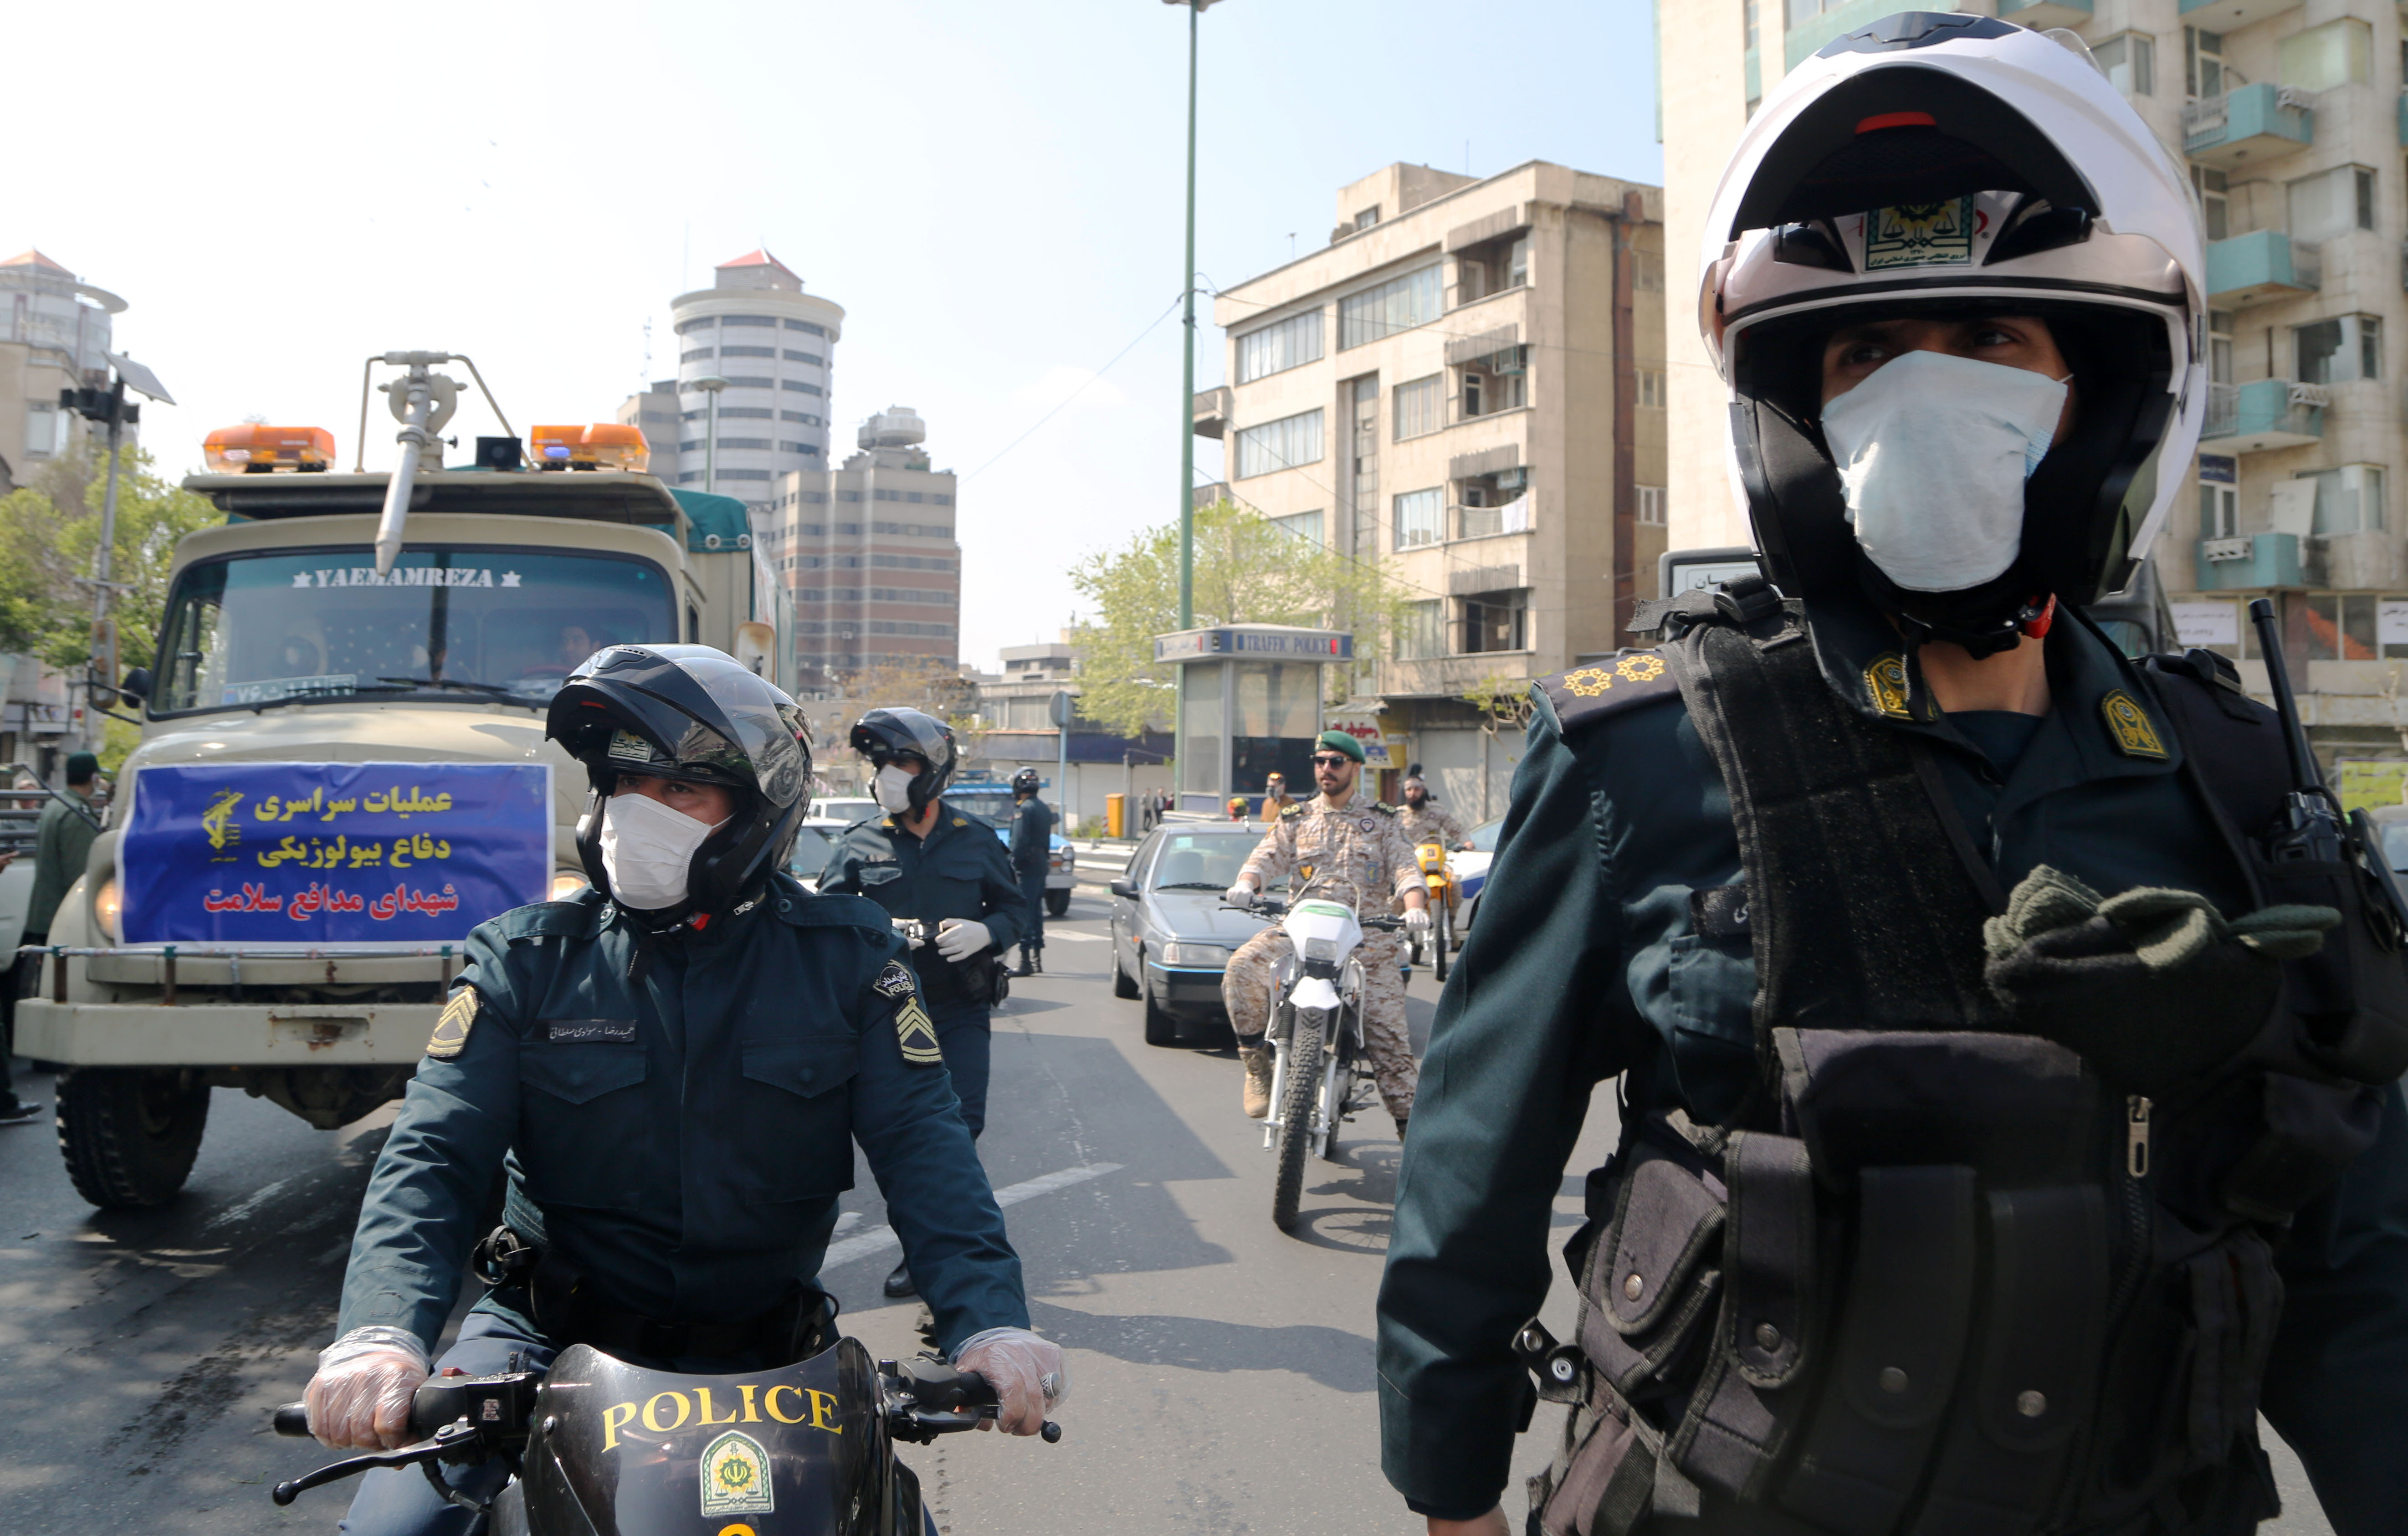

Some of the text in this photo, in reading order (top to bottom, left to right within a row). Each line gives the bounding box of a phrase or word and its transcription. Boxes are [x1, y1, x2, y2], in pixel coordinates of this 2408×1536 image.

[315, 568, 493, 588] YAEMAMREZA
[1247, 635, 1329, 654] TRAFFIC POLICE
[254, 785, 452, 821] عملیات سراسری
[257, 832, 451, 868] دفاع بیولوژیکی
[203, 882, 459, 921] شهدای مدافع سلامت
[888, 981, 915, 996] POLICE
[601, 1385, 842, 1453] POLICE
